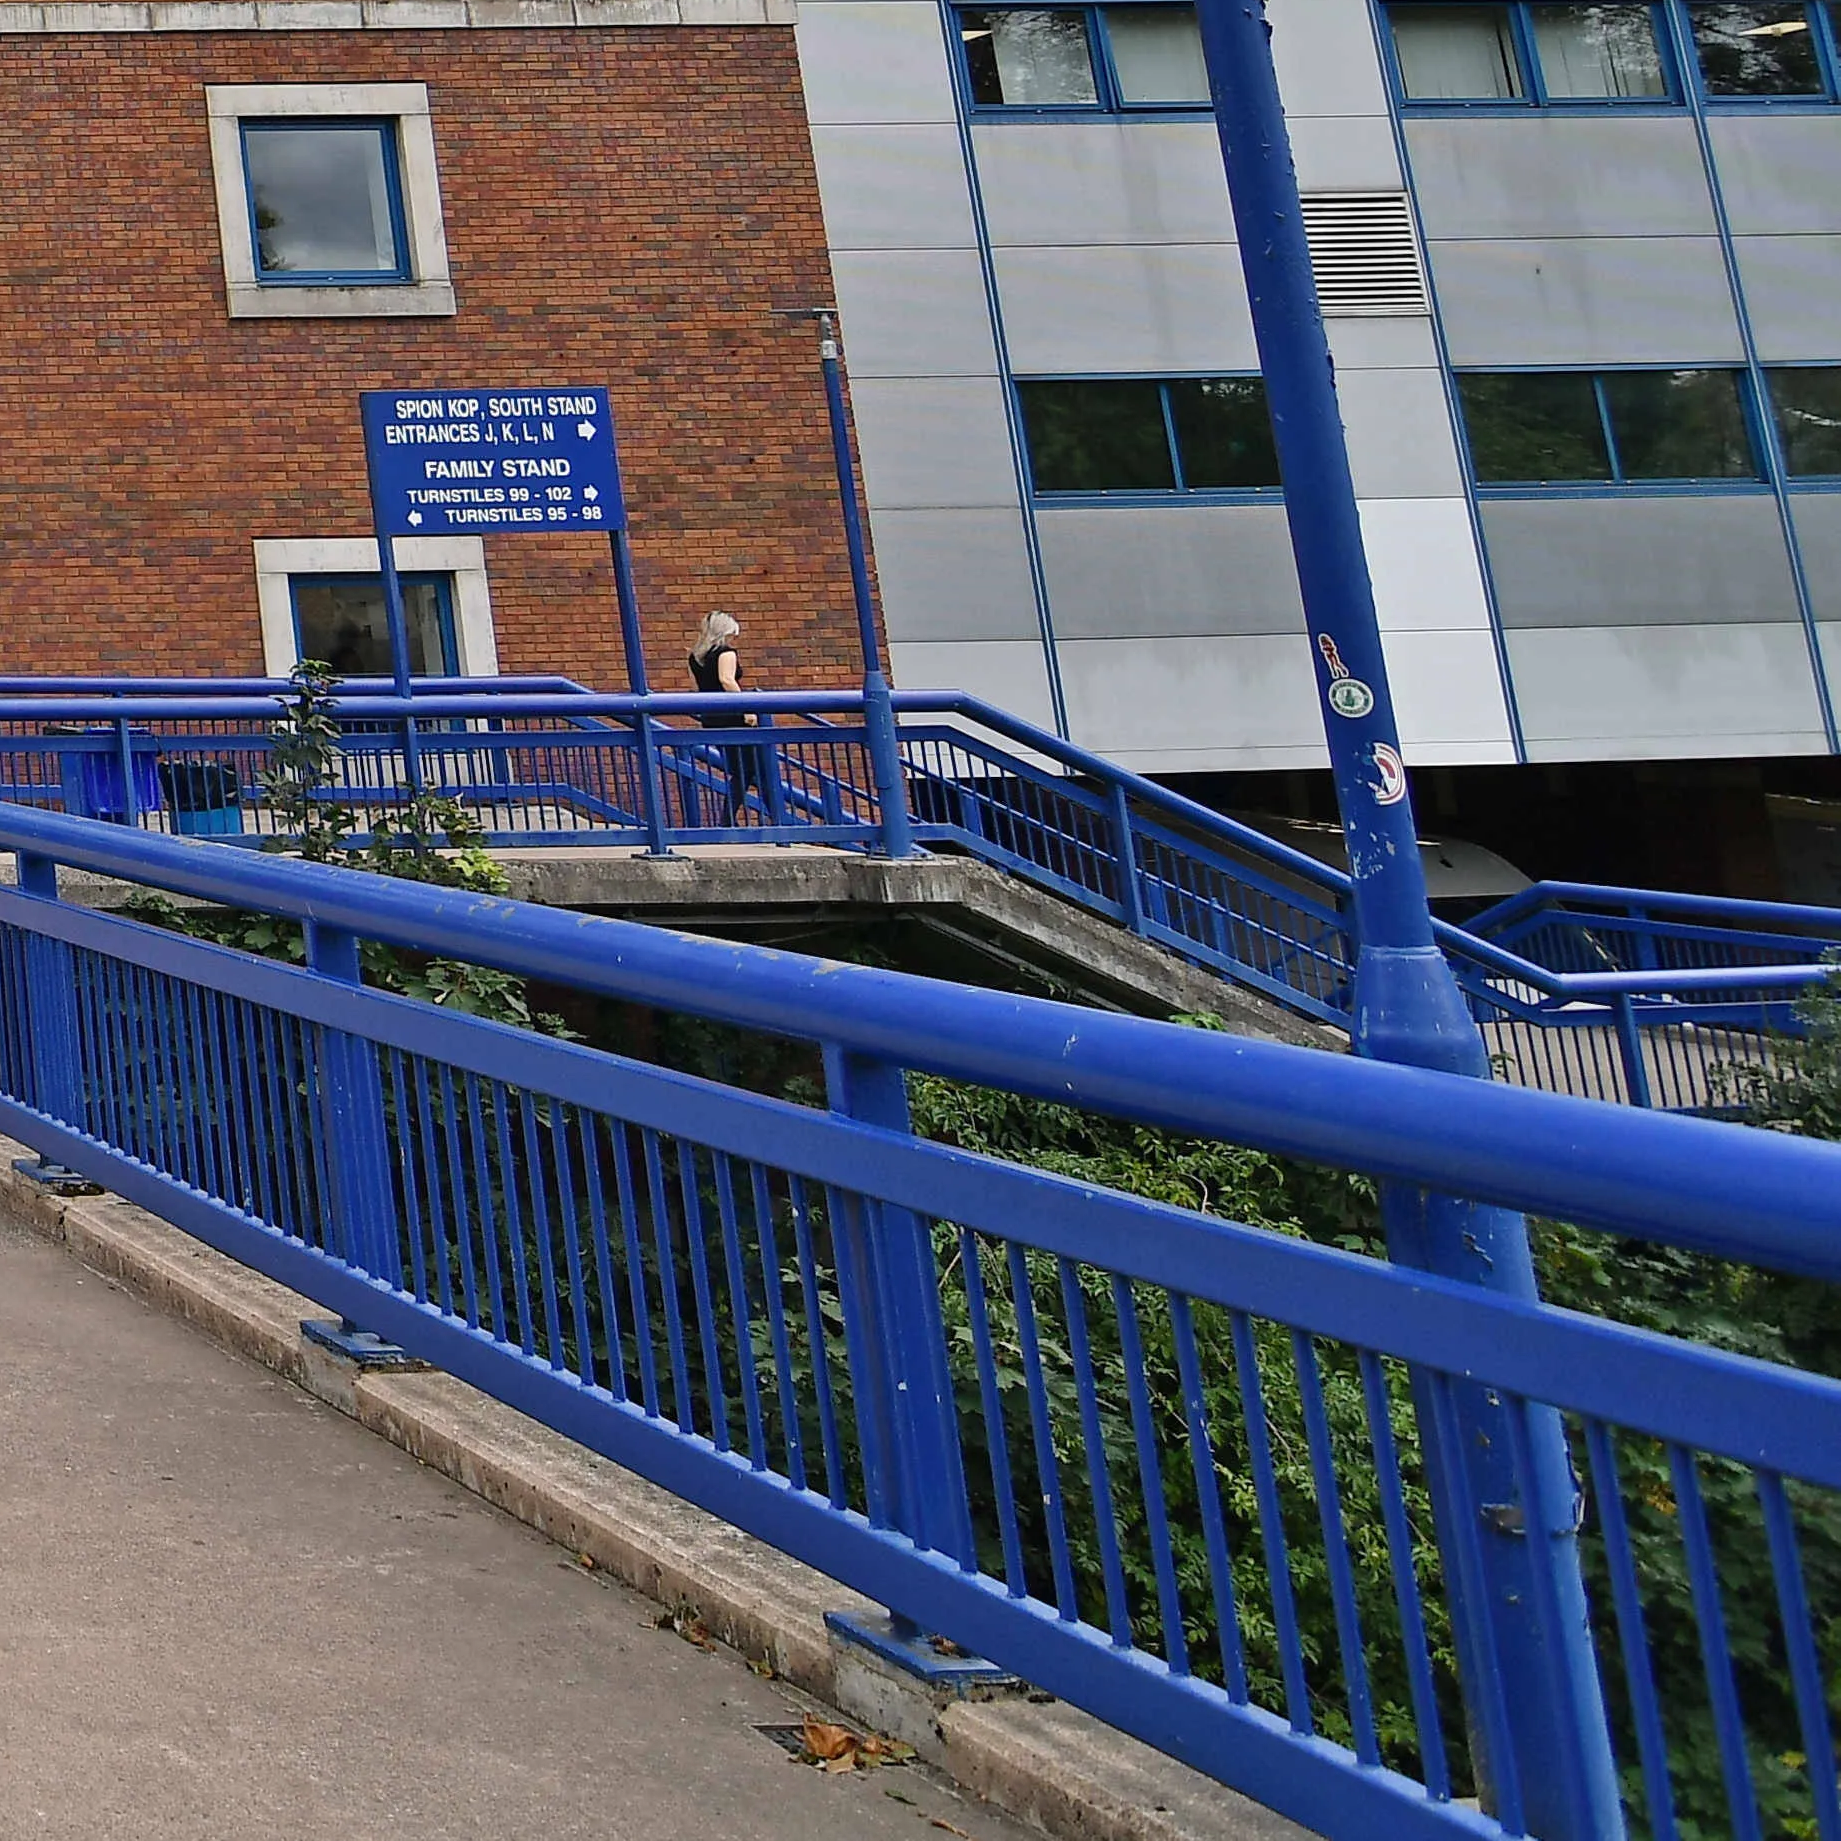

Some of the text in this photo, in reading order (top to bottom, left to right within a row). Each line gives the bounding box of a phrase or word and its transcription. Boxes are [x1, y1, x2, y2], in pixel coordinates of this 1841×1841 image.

[396, 400, 443, 419] SPION
[489, 398, 543, 417] SOUTH
[548, 397, 596, 416] STAND
[385, 422, 554, 445] ENTRANCES J, K, L, N
[425, 459, 570, 479] FAMILY STAND
[407, 489, 505, 504] TURNSTILES
[509, 488, 529, 502] 99
[546, 487, 573, 501] 102
[445, 509, 543, 524] TURNSTILES
[547, 507, 566, 521] 95
[582, 506, 602, 520] 98
